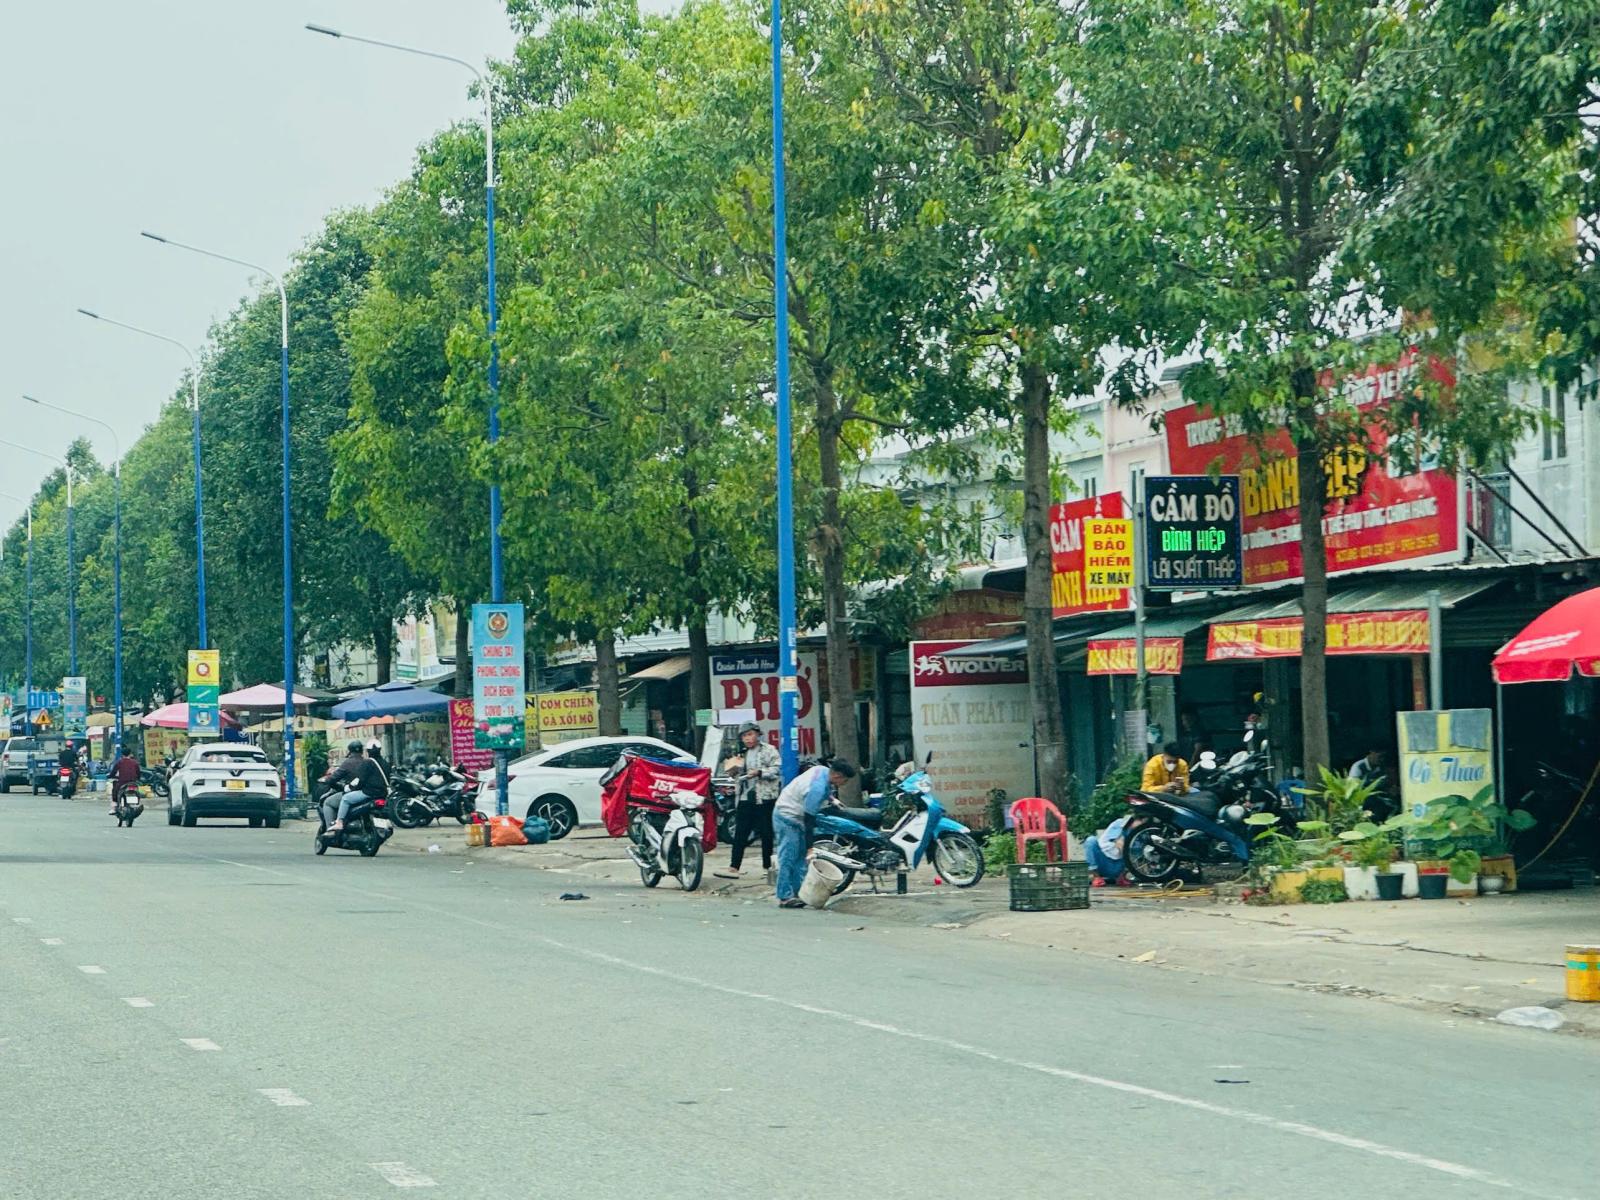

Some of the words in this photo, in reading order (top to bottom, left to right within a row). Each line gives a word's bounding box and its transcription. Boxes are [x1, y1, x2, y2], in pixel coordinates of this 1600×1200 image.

[1150, 482, 1198, 522] CẦM
[1204, 482, 1235, 522] ĐỒ
[1050, 505, 1082, 553] CẦM
[1093, 521, 1126, 535] BÁN
[1093, 537, 1126, 551] BẢO
[1162, 526, 1192, 551] BÌNH
[1196, 526, 1226, 553] HIỆP
[1088, 553, 1131, 567] HIỂM
[1153, 558, 1171, 579] LÃI
[1172, 554, 1203, 579] SUẤT
[1206, 554, 1237, 579] THẤP
[1089, 572, 1104, 585] XE
[1106, 569, 1131, 585] MÁY
[944, 657, 1025, 674] WOLVER
[543, 713, 557, 726] GÀ
